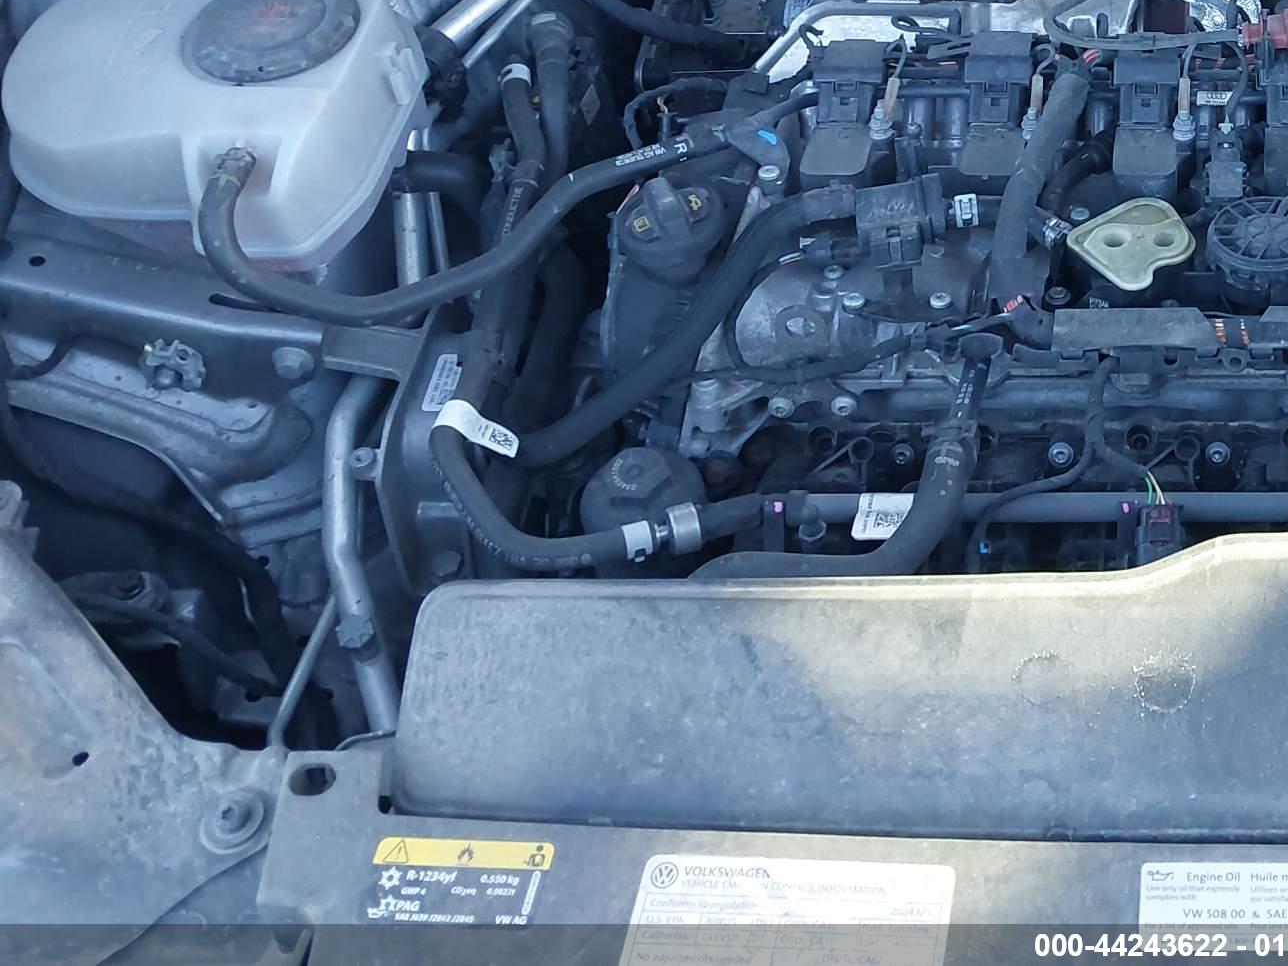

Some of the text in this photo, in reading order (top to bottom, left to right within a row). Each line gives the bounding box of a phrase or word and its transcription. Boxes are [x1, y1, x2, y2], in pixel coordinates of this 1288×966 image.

[405, 869, 458, 884] R-1234yf
[508, 875, 520, 886] kg
[684, 865, 771, 879] VOLKSWAGEN
[1186, 872, 1240, 884] Engine Oil
[1250, 872, 1279, 882] Huile
[395, 900, 421, 912] PAG
[1183, 908, 1203, 918] VW
[1206, 908, 1227, 919] 508
[1230, 908, 1246, 919] 00
[1266, 909, 1288, 919] SAE
[495, 915, 528, 925] VW AG
